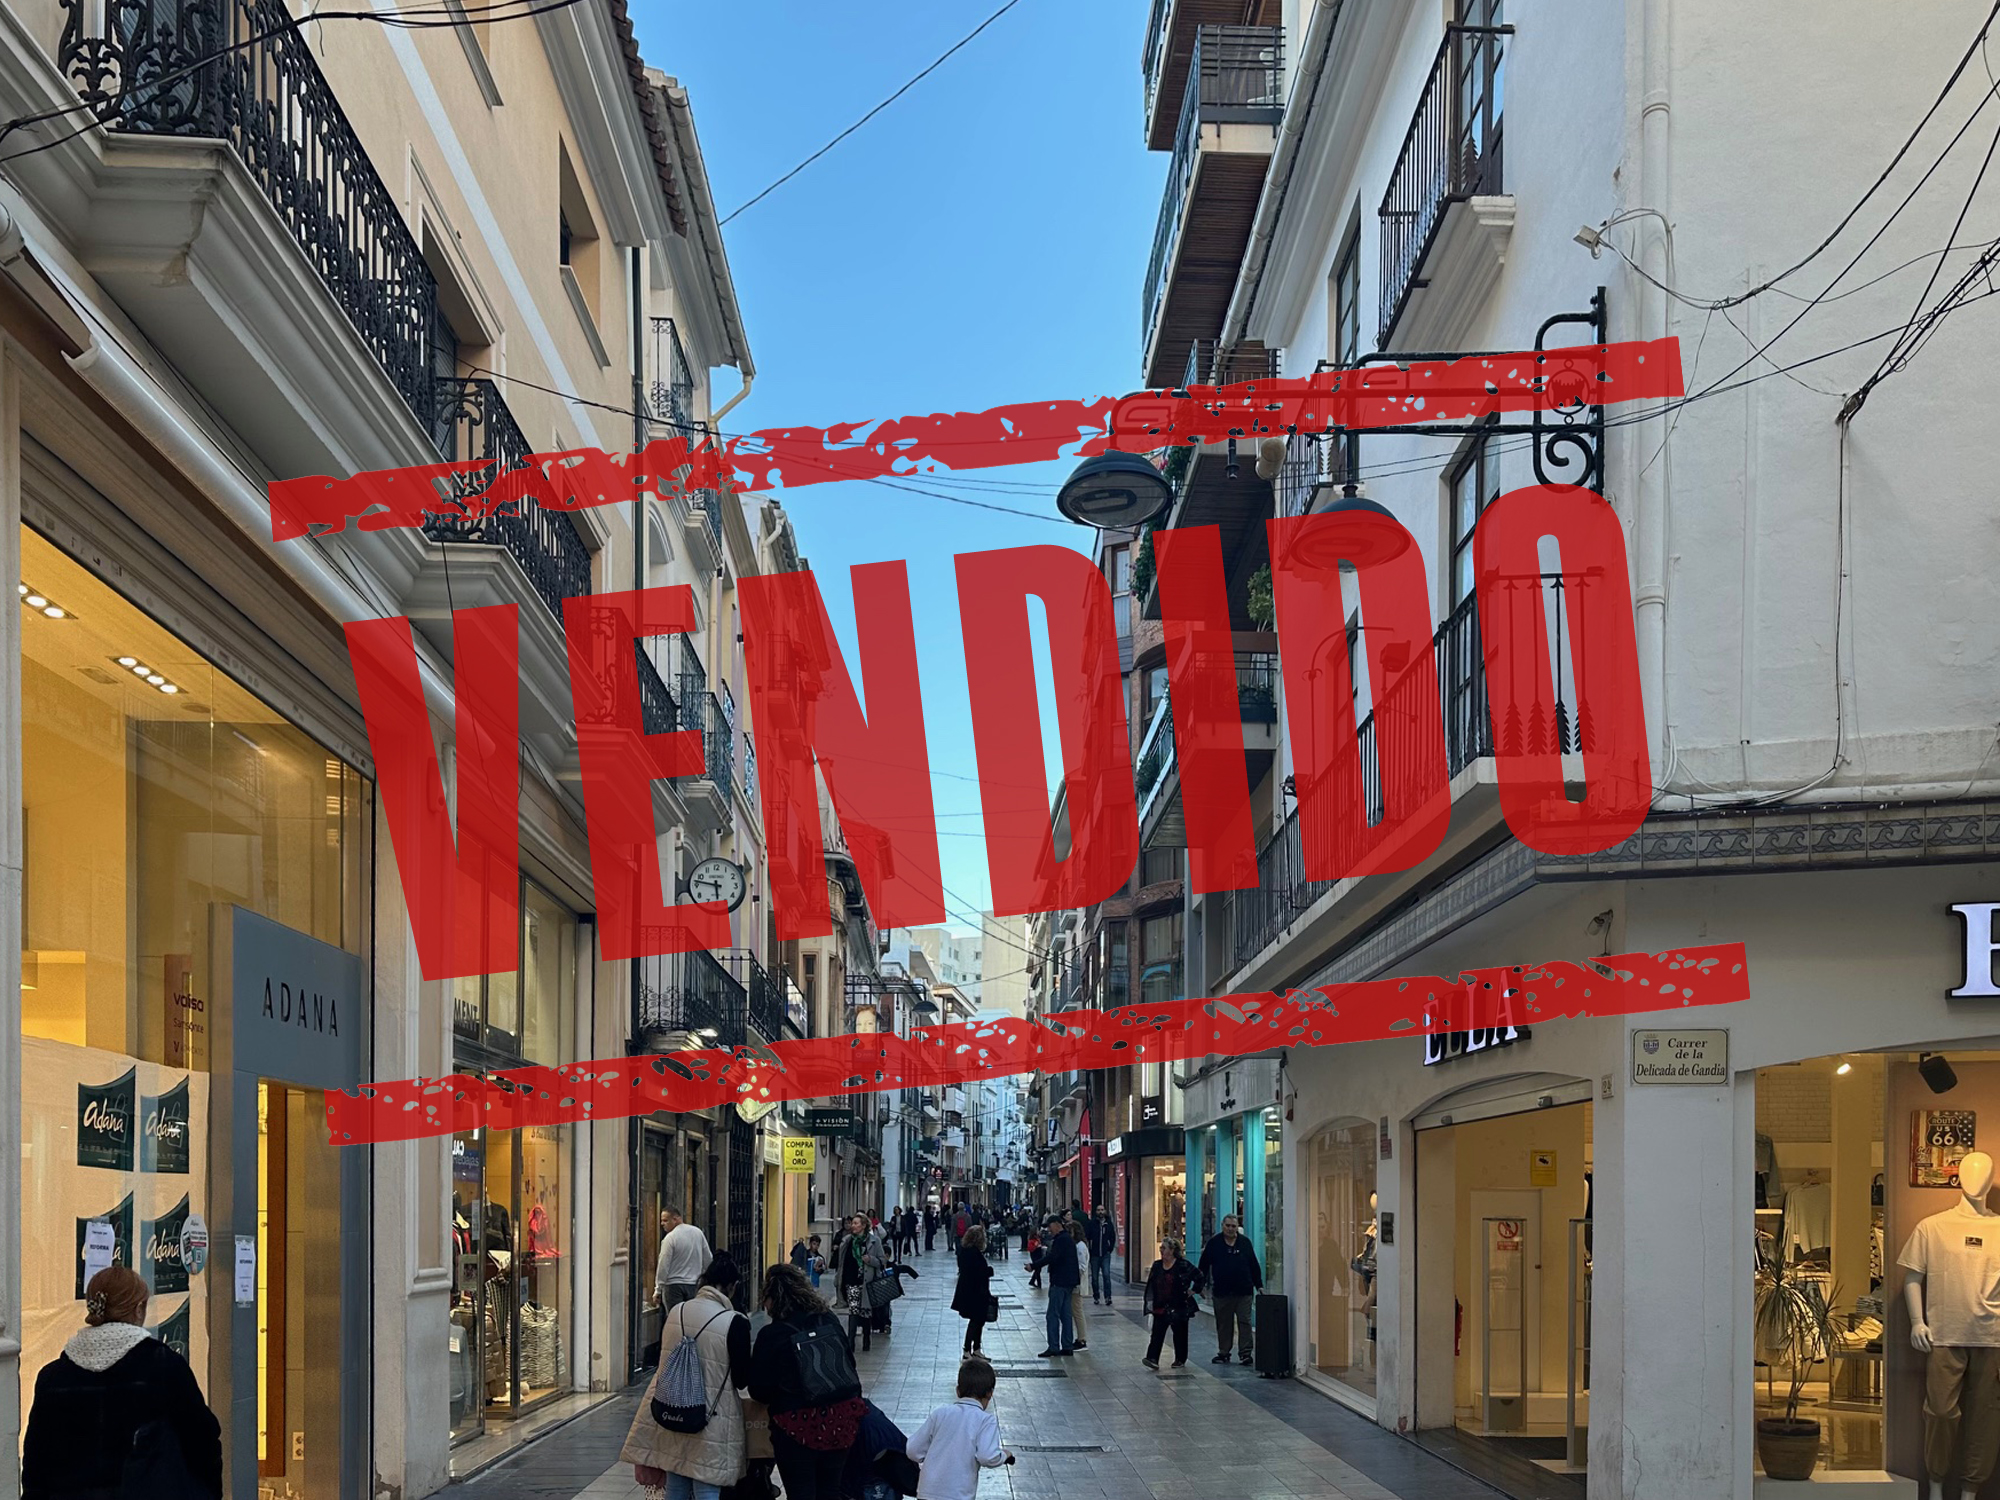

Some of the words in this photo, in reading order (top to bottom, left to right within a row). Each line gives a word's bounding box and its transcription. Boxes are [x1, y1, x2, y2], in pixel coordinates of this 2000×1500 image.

[262, 977, 338, 1037] ADANA
[1667, 1037, 1708, 1048] Carrer
[1675, 1049, 1690, 1059] de
[1692, 1049, 1704, 1059] la
[1636, 1064, 1677, 1076] Delicada
[1677, 1064, 1690, 1076] de
[1691, 1063, 1726, 1076] Gandia
[1932, 1132, 1954, 1146] 66
